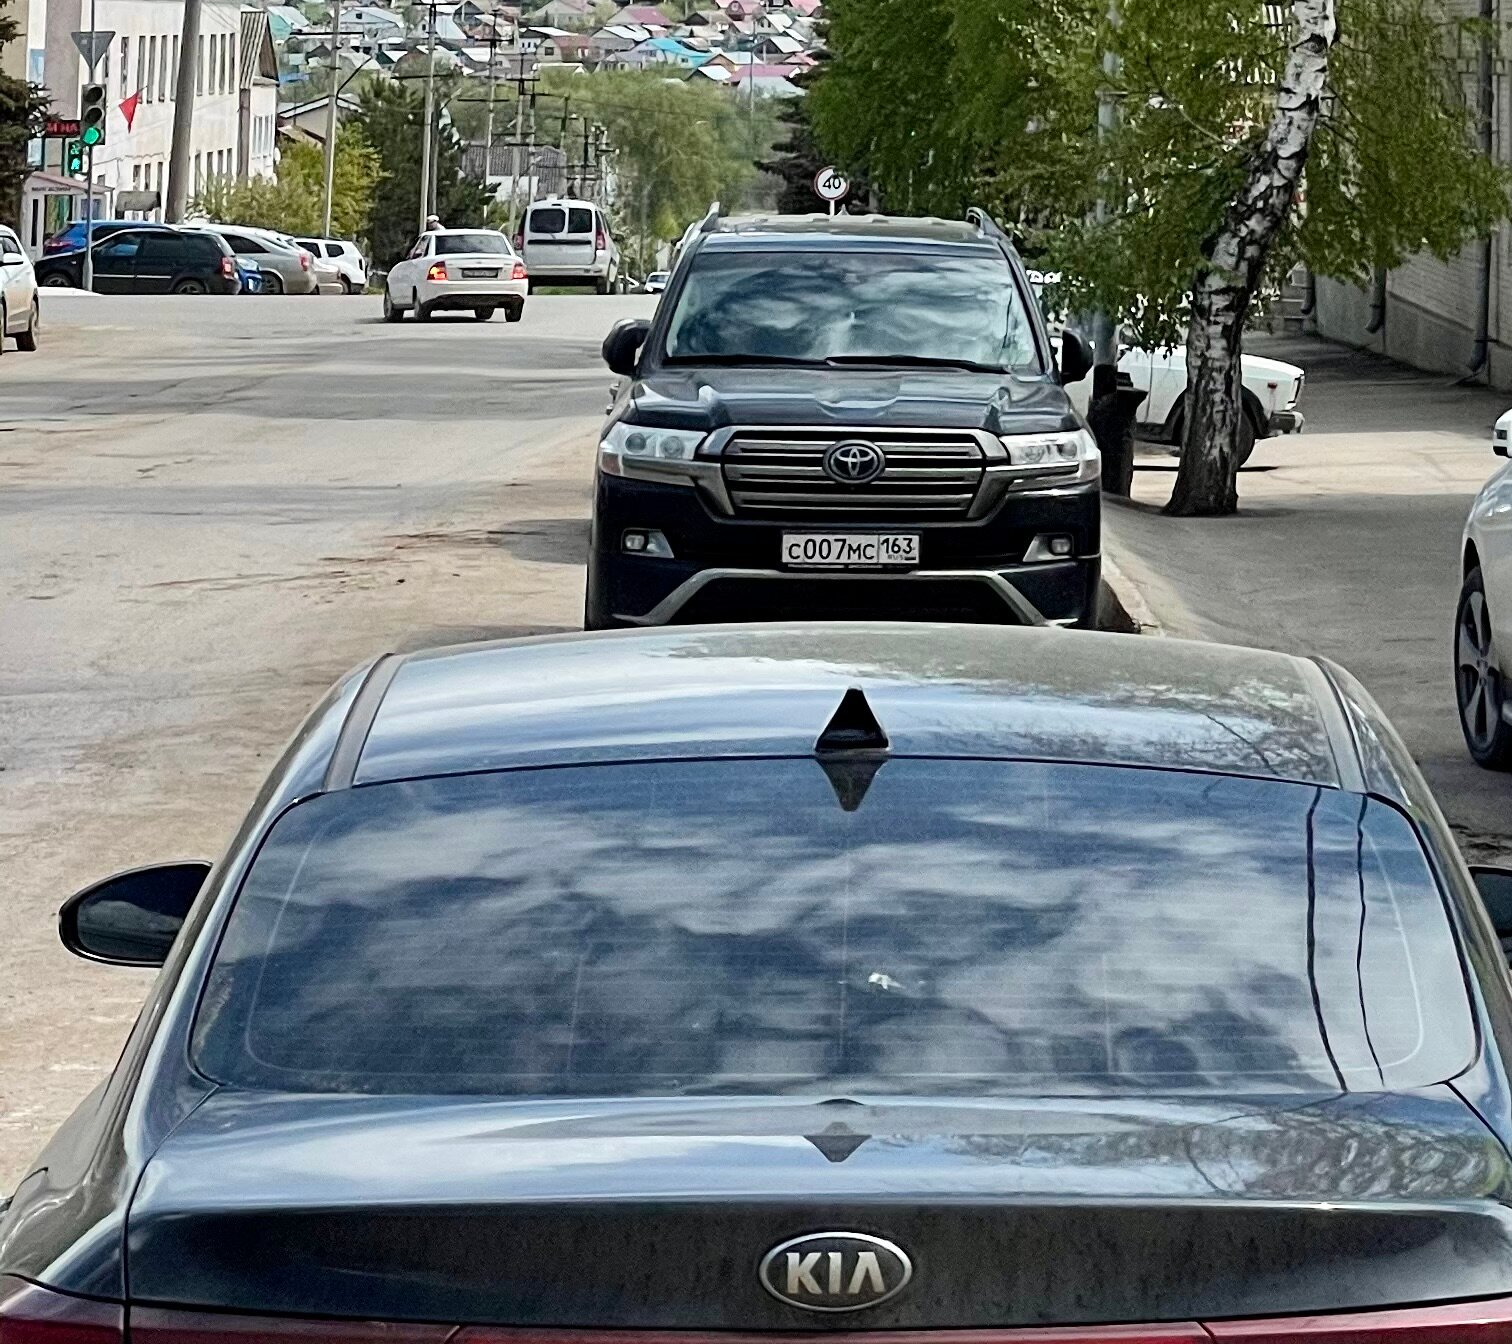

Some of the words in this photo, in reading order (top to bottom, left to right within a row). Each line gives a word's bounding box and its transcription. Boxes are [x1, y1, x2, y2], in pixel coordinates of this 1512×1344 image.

[822, 174, 842, 190] 40
[787, 537, 876, 561] С007МС
[880, 537, 914, 555] 163
[785, 1251, 886, 1295] KIA
